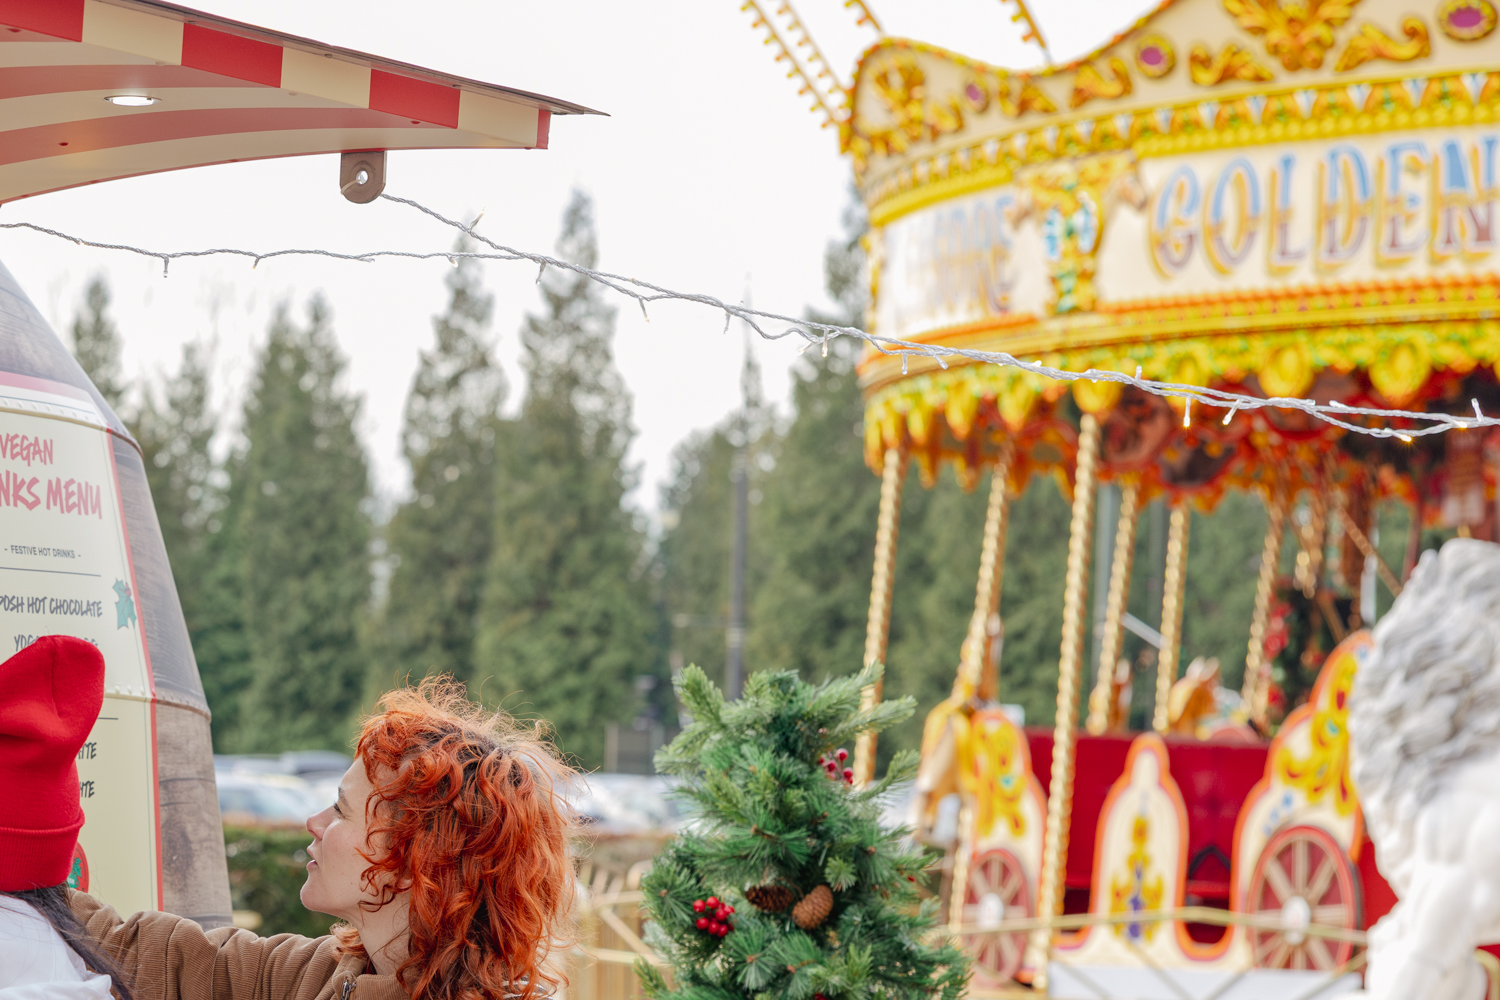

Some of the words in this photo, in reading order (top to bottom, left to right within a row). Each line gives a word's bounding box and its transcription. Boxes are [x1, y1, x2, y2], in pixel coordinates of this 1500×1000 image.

[1148, 135, 1500, 280] GOLDEN
[46, 477, 102, 520] MENU
[10, 545, 37, 556] FESTIVE
[38, 547, 51, 557] HOT
[52, 548, 75, 559] DRINKS
[27, 596, 48, 615] HOT
[50, 597, 103, 618] CHOCOLATE
